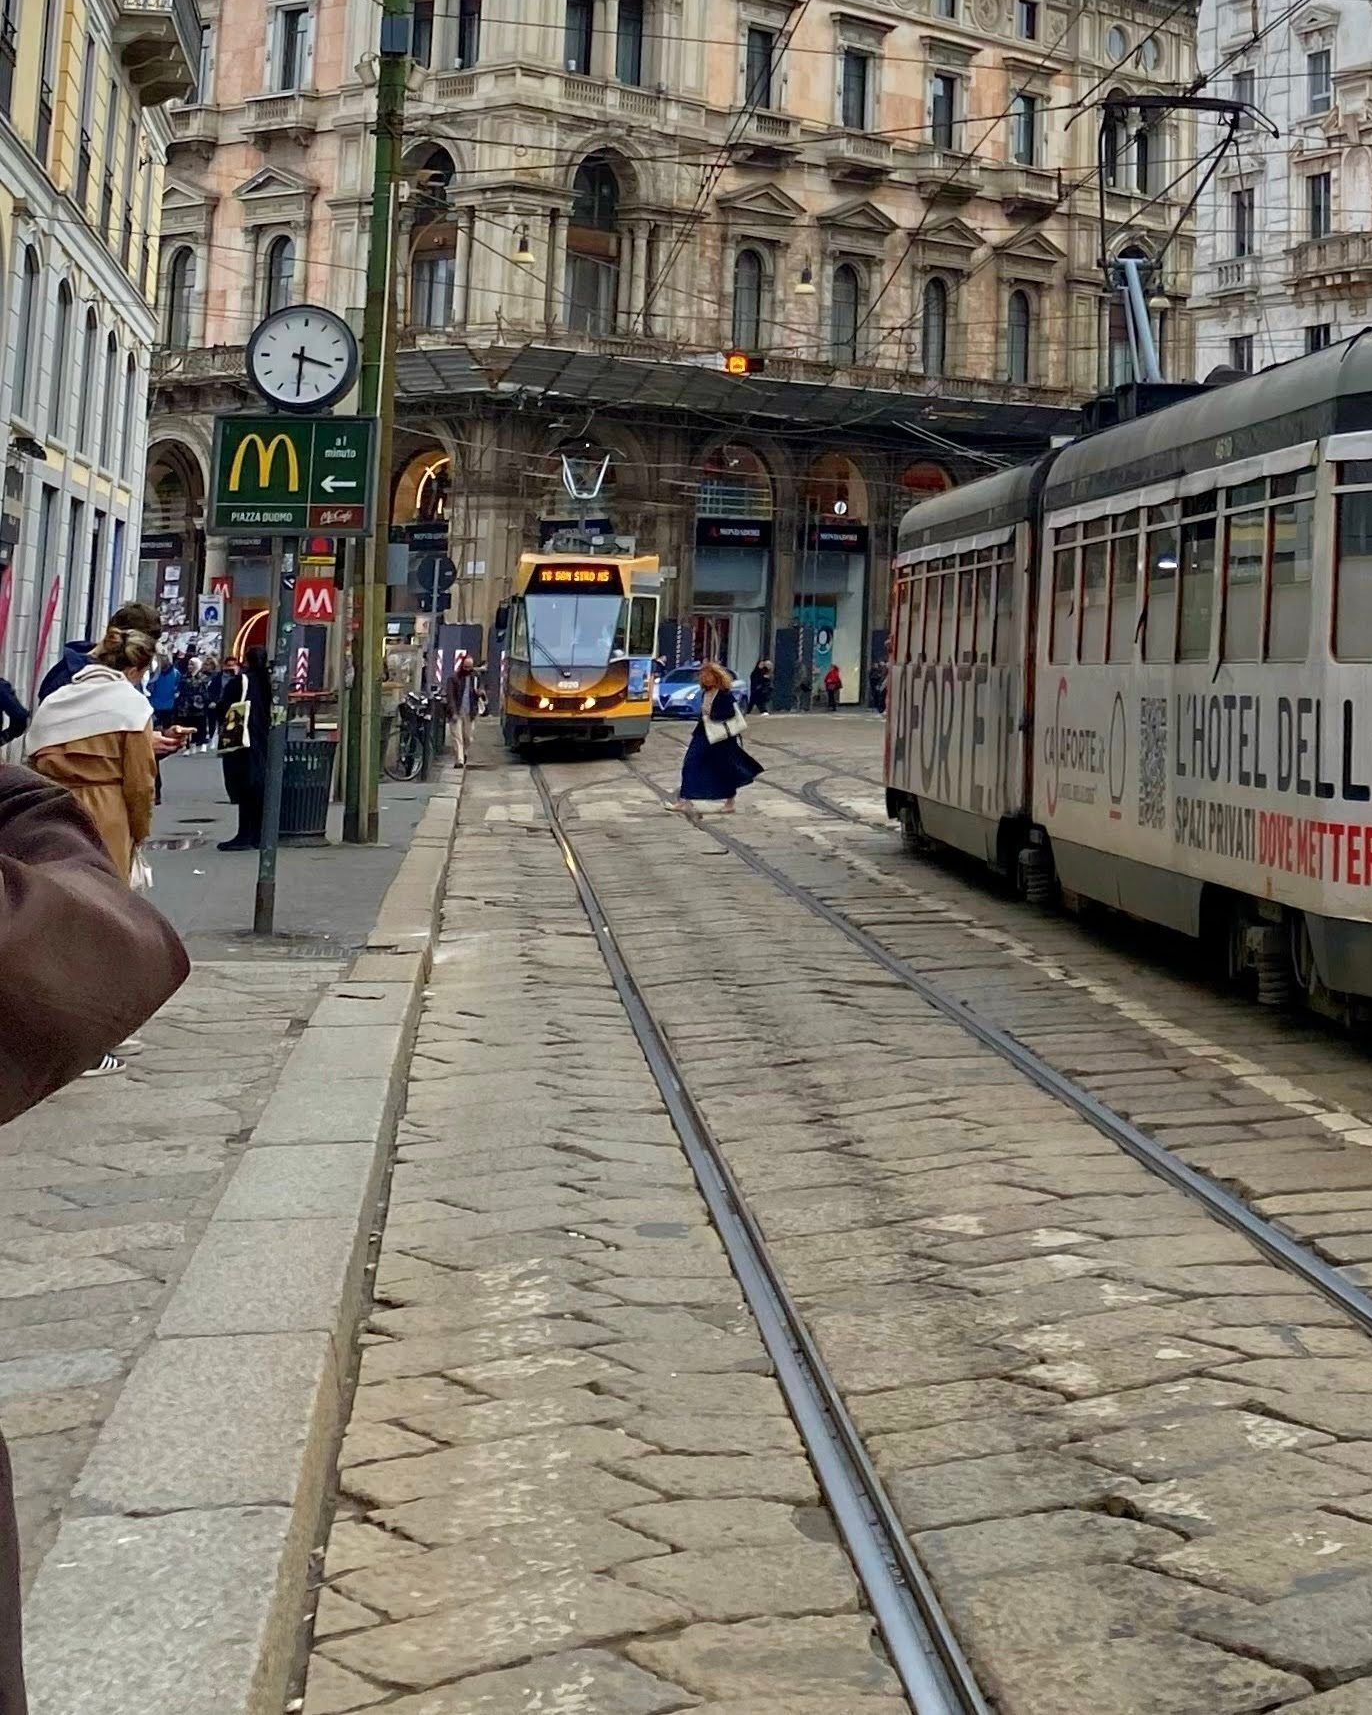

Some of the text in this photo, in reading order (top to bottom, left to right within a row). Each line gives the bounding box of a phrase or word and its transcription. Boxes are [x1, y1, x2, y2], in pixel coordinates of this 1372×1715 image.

[324, 447, 357, 458] minuto
[231, 511, 293, 522] PIAZZA DUOMO
[298, 588, 333, 614] M
[1175, 693, 1267, 789] L'HOTEL
[1175, 796, 1206, 850] SPAZI
[1208, 802, 1256, 862] PRIVATI
[1259, 811, 1293, 873] DOVE
